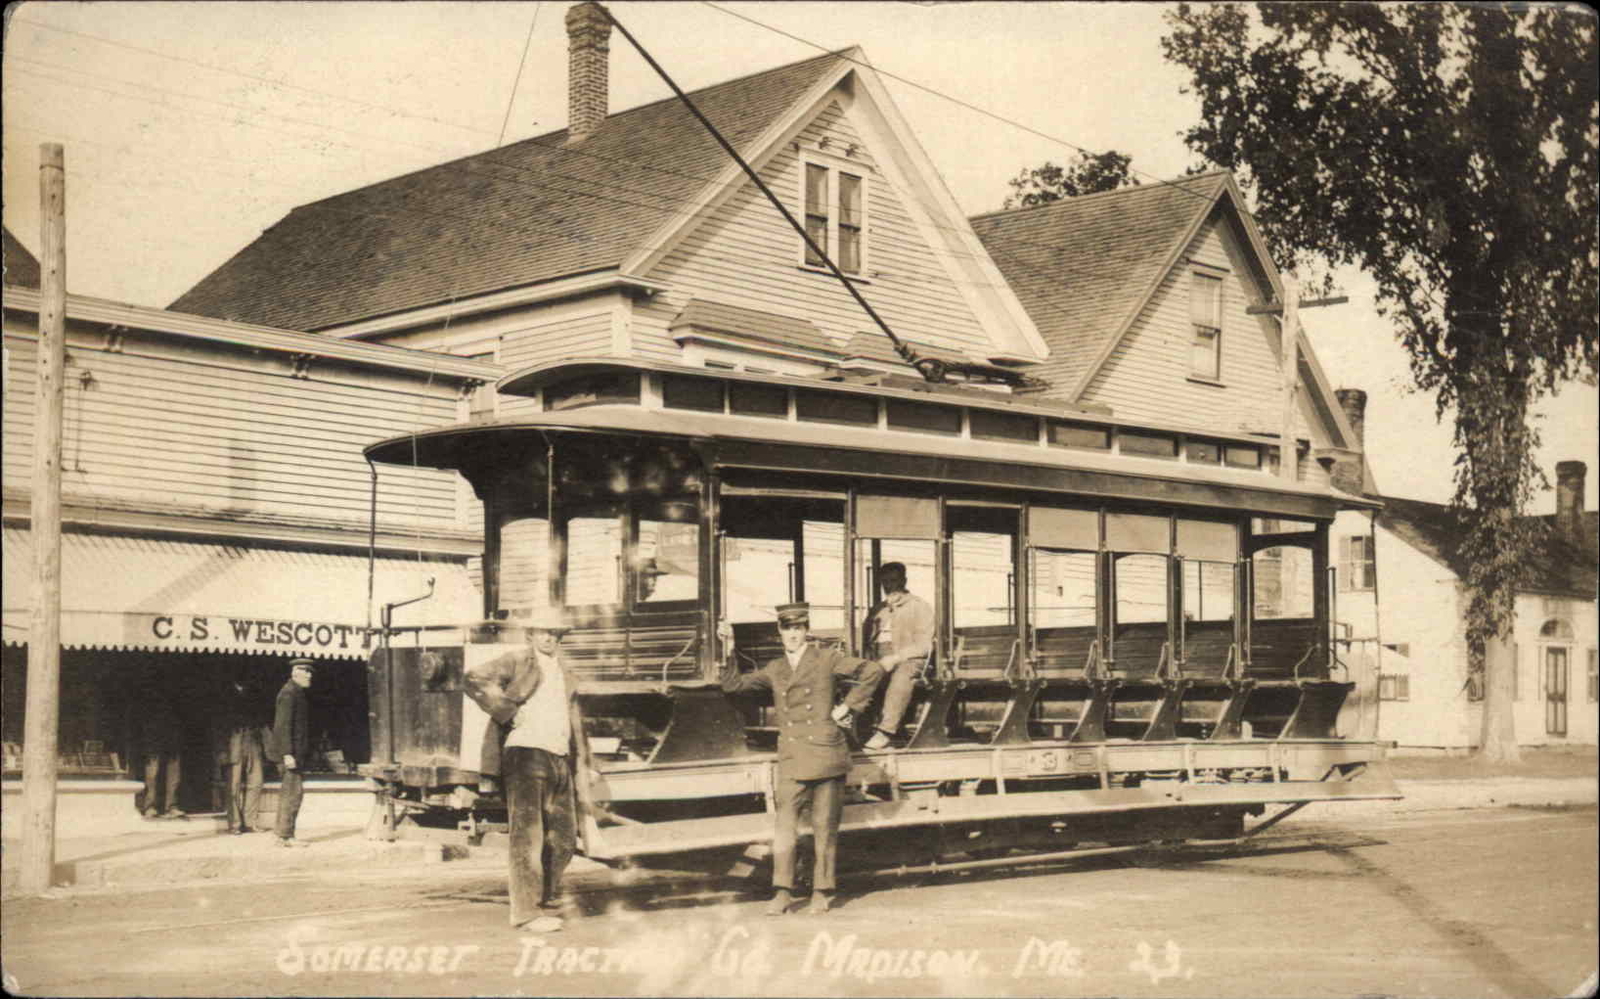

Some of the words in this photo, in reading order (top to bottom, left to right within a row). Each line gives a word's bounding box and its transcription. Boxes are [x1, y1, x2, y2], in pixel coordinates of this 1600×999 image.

[152, 616, 181, 640] C.
[190, 618, 219, 641] S.
[229, 619, 371, 649] WESCOTT
